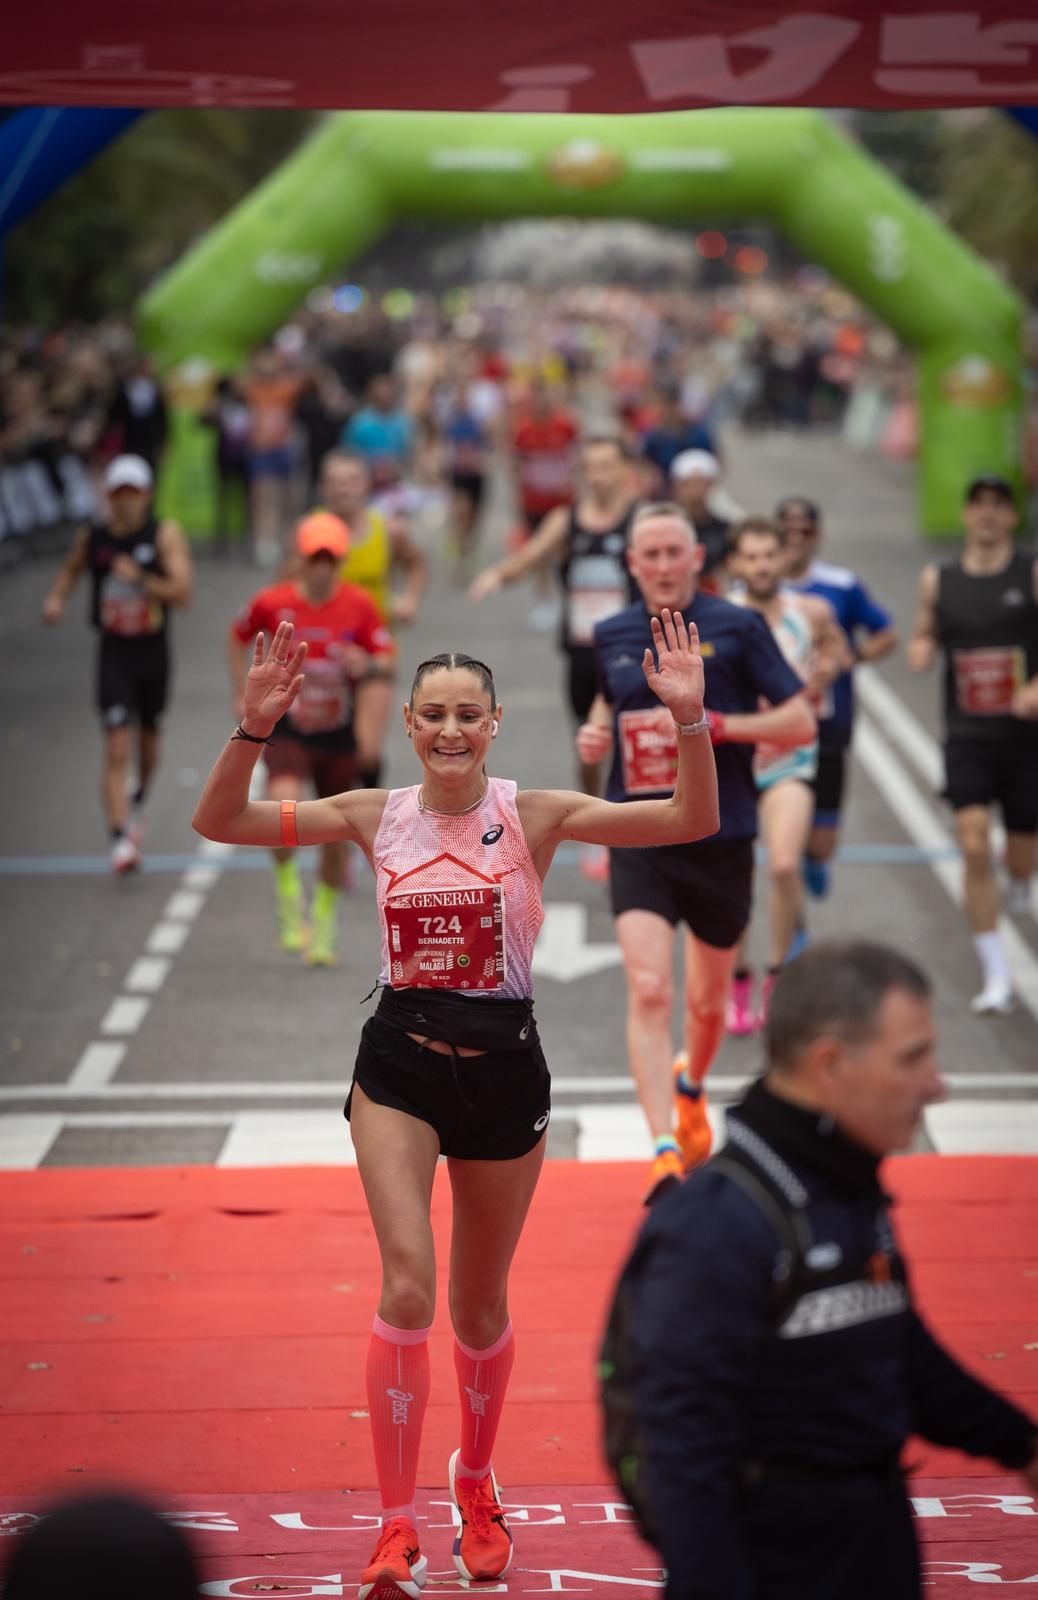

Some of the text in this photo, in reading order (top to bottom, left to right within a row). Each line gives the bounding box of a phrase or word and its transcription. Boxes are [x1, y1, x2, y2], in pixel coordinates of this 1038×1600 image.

[412, 890, 485, 908] GENERALI
[494, 909, 502, 923] BOX
[417, 915, 462, 934] 724
[418, 937, 465, 945] BERNADETTE
[495, 958, 503, 972] BOX
